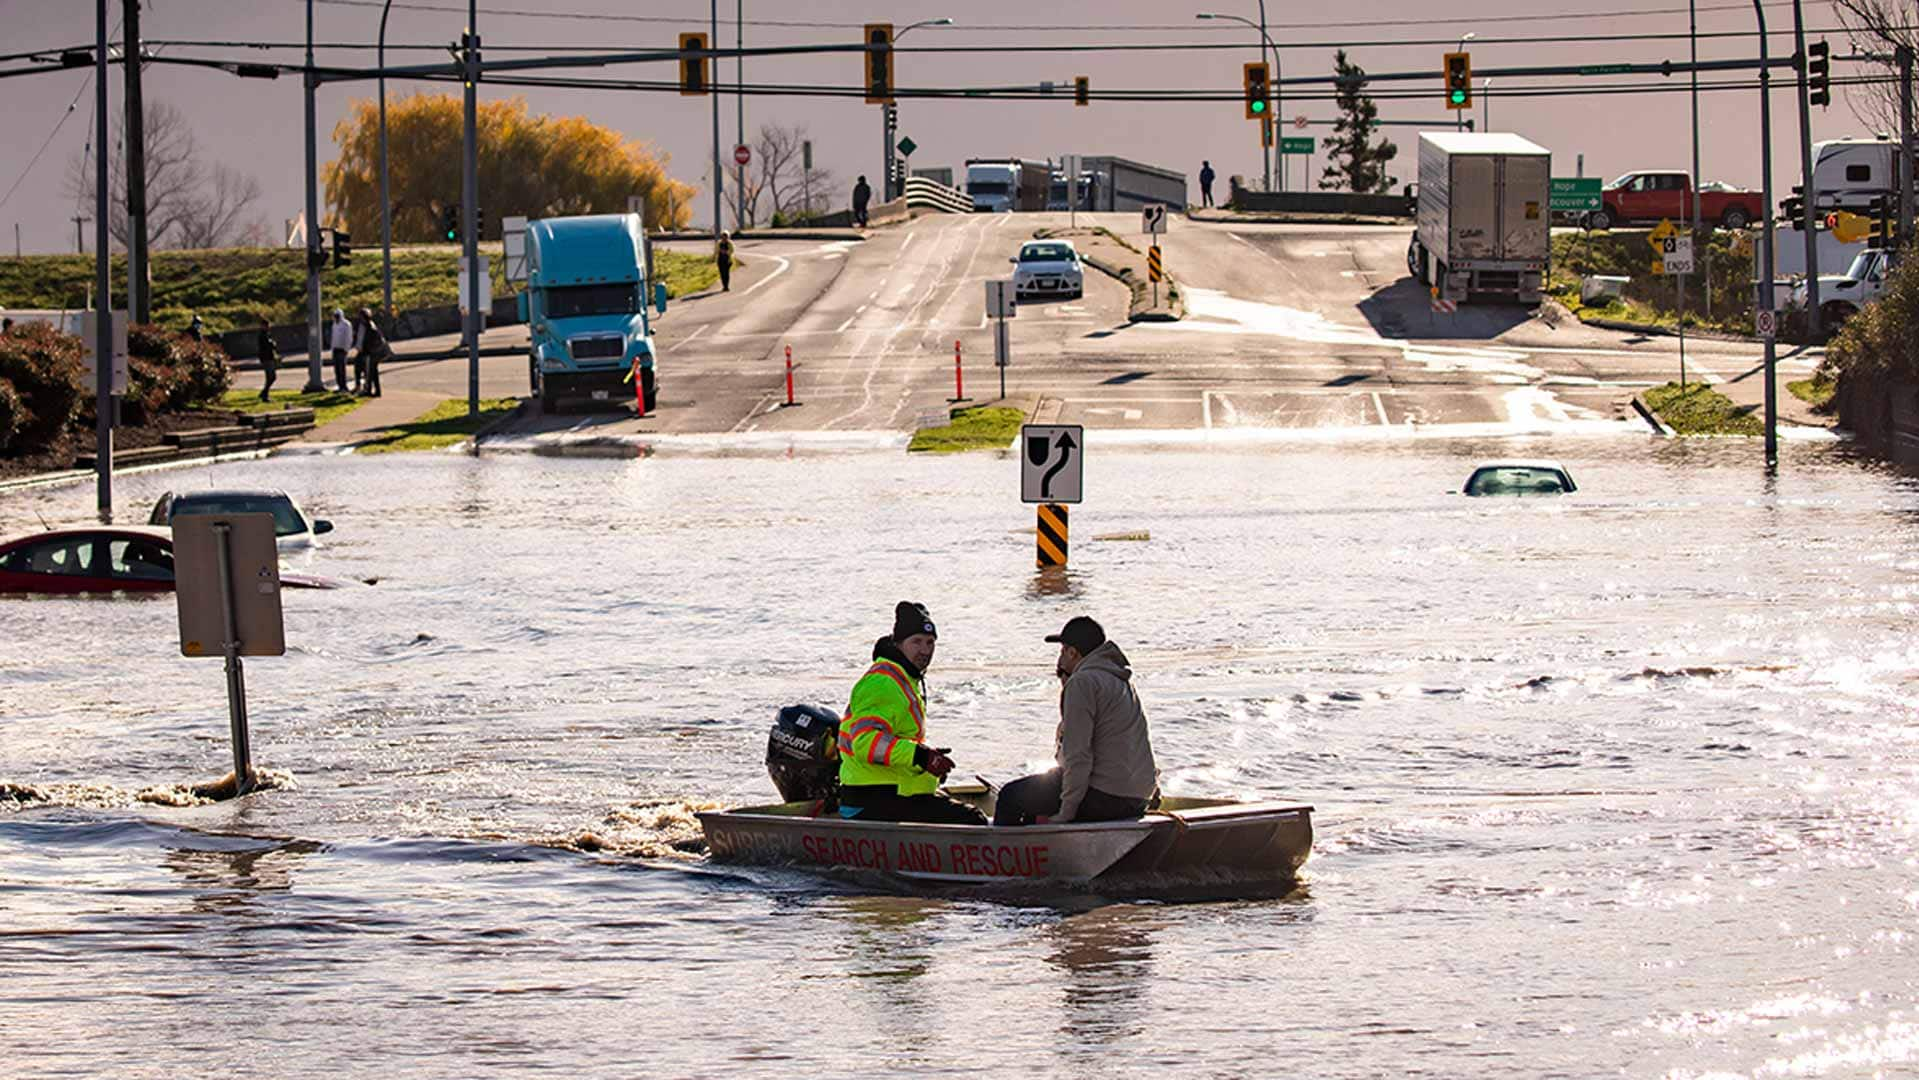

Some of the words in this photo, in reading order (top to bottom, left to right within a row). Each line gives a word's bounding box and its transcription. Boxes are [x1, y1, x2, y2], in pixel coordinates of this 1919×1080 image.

[1667, 260, 1690, 271] ENDS
[802, 835, 889, 871] SEARCH
[898, 841, 943, 873] AND
[949, 845, 1050, 877] RESCUE
